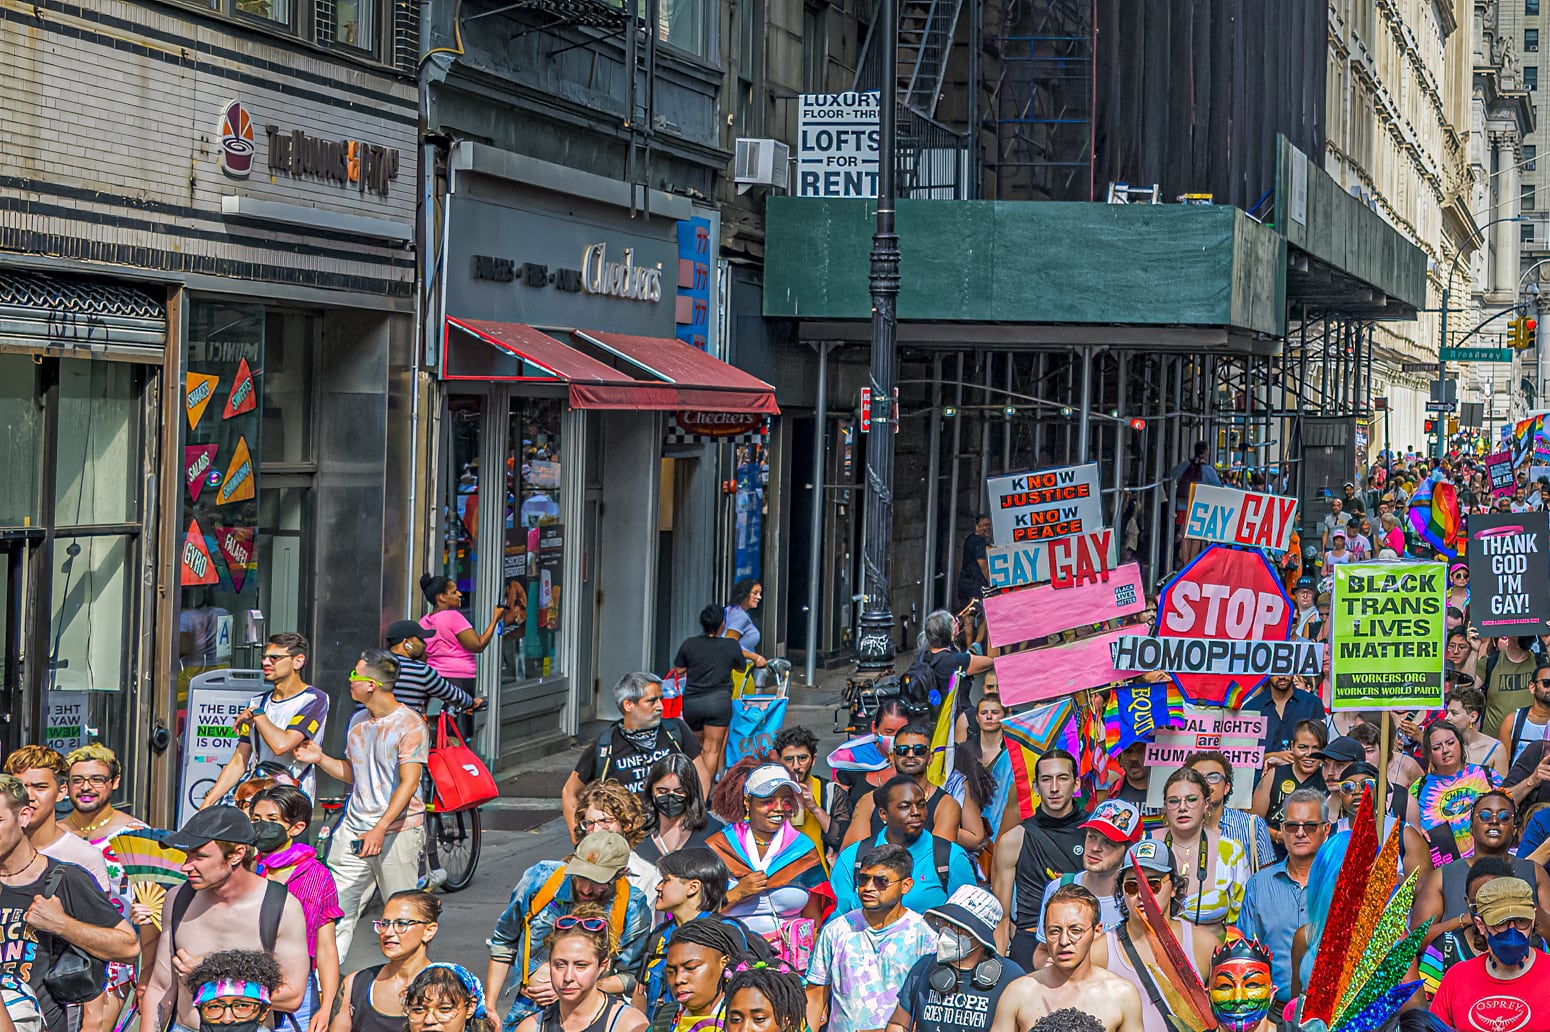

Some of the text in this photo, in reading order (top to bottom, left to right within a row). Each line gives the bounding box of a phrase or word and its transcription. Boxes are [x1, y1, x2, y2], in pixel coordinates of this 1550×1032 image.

[804, 94, 880, 107] LUXURY
[802, 130, 880, 151] LOFTS
[826, 156, 858, 167] FOR
[801, 171, 880, 196] RENT
[1450, 349, 1501, 361] Broadway
[683, 411, 754, 425] Checkers
[1012, 470, 1075, 492] KNOW
[1002, 484, 1090, 508] JUSTICE
[1015, 506, 1078, 527] KNOW
[1187, 493, 1297, 549] SAY GAY
[1014, 520, 1082, 541] PEACE
[224, 533, 249, 569] FALAFEL
[1480, 533, 1538, 556] THANK
[184, 542, 207, 579] GYRO
[989, 530, 1112, 590] SAY GAY
[1492, 554, 1528, 575] GOD
[1348, 574, 1437, 594] BLACK
[1498, 575, 1522, 594] I'M
[1116, 591, 1135, 600] LIVES
[1491, 594, 1530, 615] GAY!
[1166, 580, 1285, 640] STOP
[1342, 597, 1440, 615] TRANS
[219, 620, 230, 646] A
[1353, 619, 1431, 638] LIVES
[1116, 636, 1319, 674] HOMOPHOBIA
[1340, 642, 1438, 659] MATTER!
[1352, 673, 1426, 684] WORKERS.ORG
[1500, 674, 1518, 692] ACT
[1337, 685, 1440, 696] WORKERS WORLD PARTY
[200, 704, 225, 714] THE
[199, 715, 228, 725] WAY
[1213, 719, 1262, 733] RIGHTS
[197, 725, 229, 737] NEW
[1198, 735, 1220, 746] are
[196, 738, 232, 748] IS ON
[942, 992, 989, 1012] HOPE
[1476, 1000, 1524, 1012] OSPREY
[923, 1005, 987, 1028] GOES TO ELEVEN
